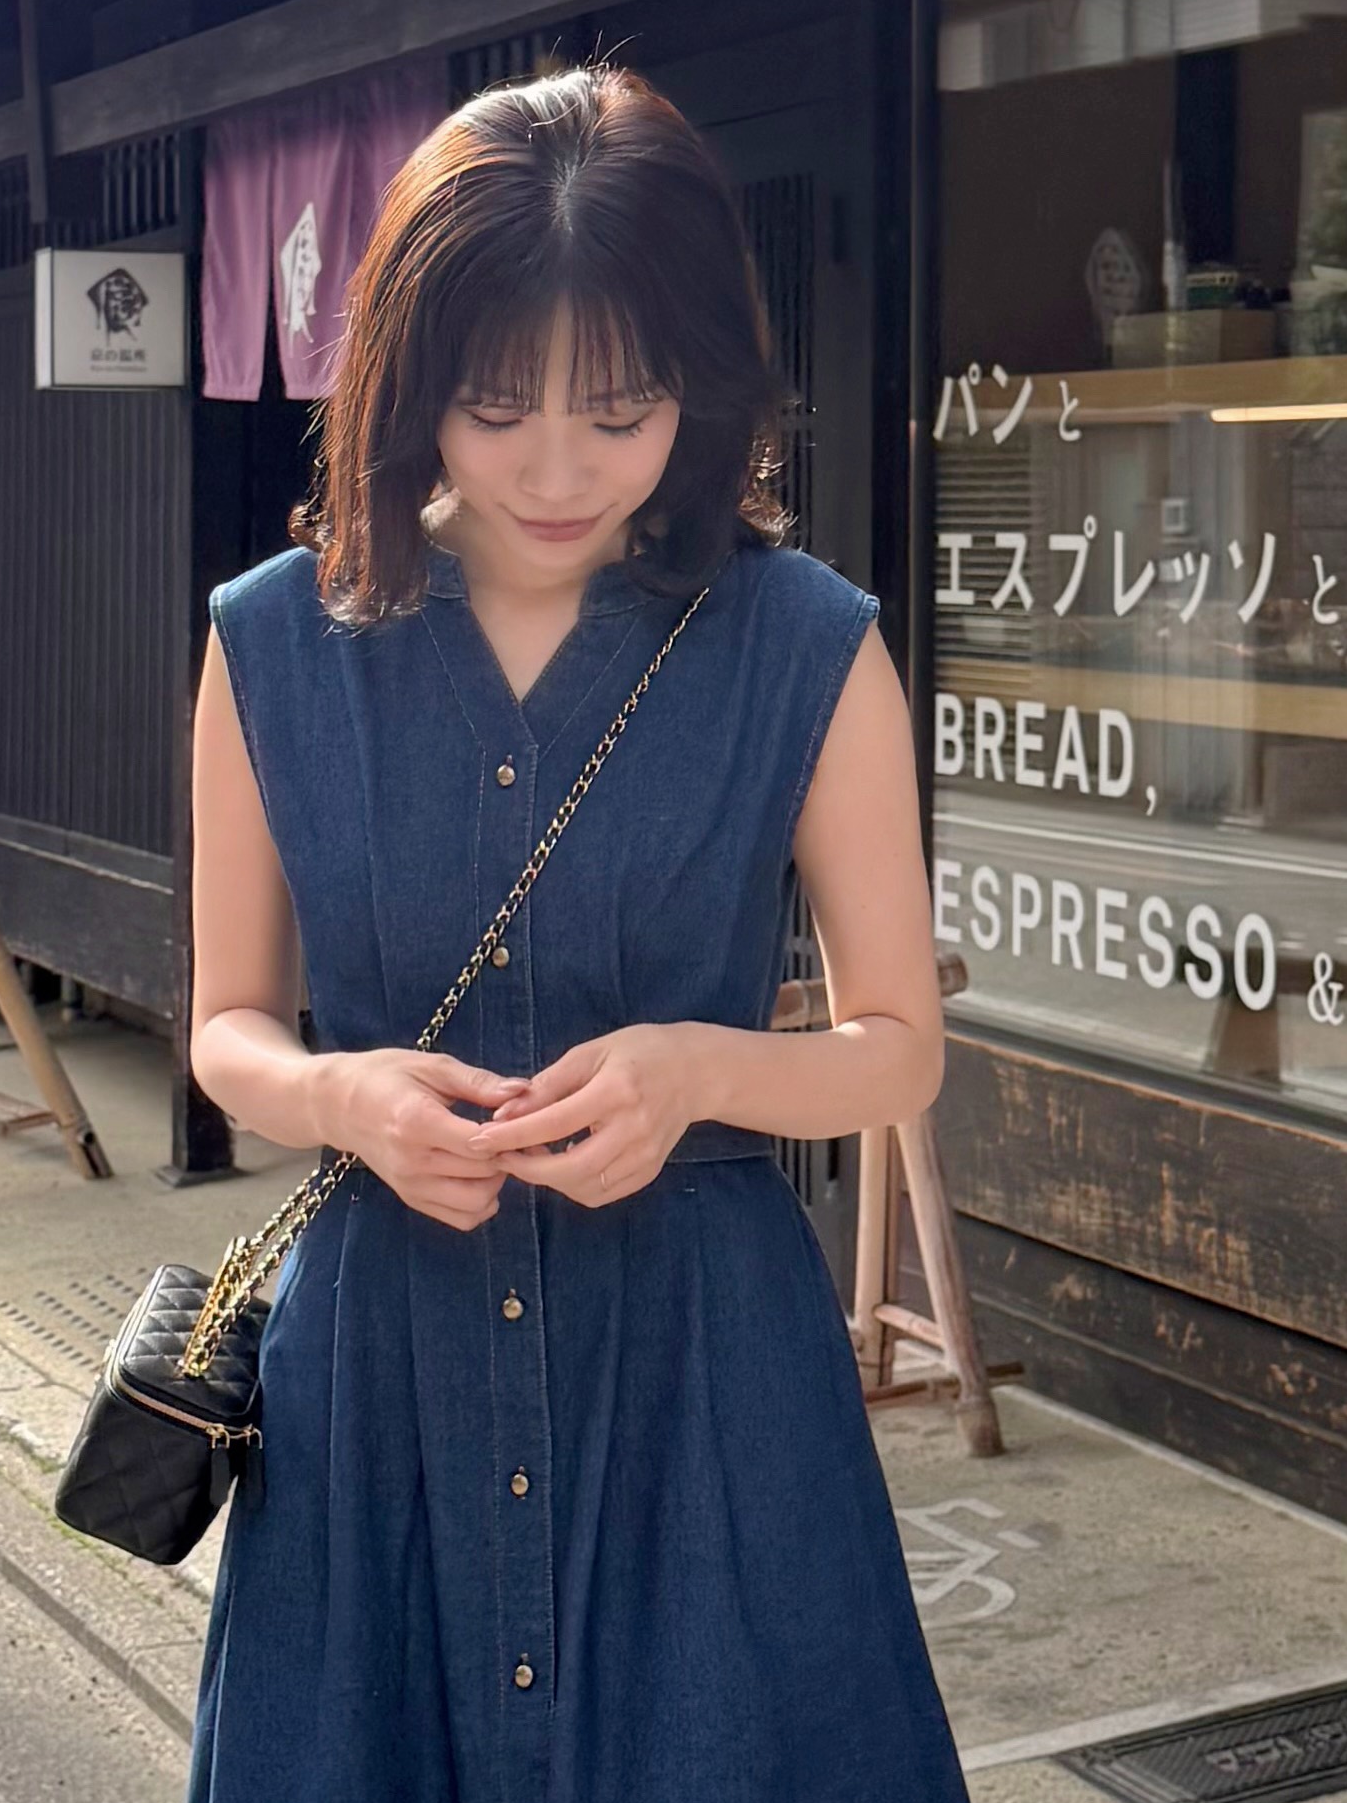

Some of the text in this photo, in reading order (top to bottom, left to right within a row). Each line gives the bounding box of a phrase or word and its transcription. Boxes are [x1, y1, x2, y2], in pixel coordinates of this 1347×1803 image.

[933, 363, 1081, 443] パンと
[935, 514, 1341, 625] エスプレッソと
[934, 693, 1157, 816] BREAD,
[934, 858, 1345, 1026] ESPRESSO &
